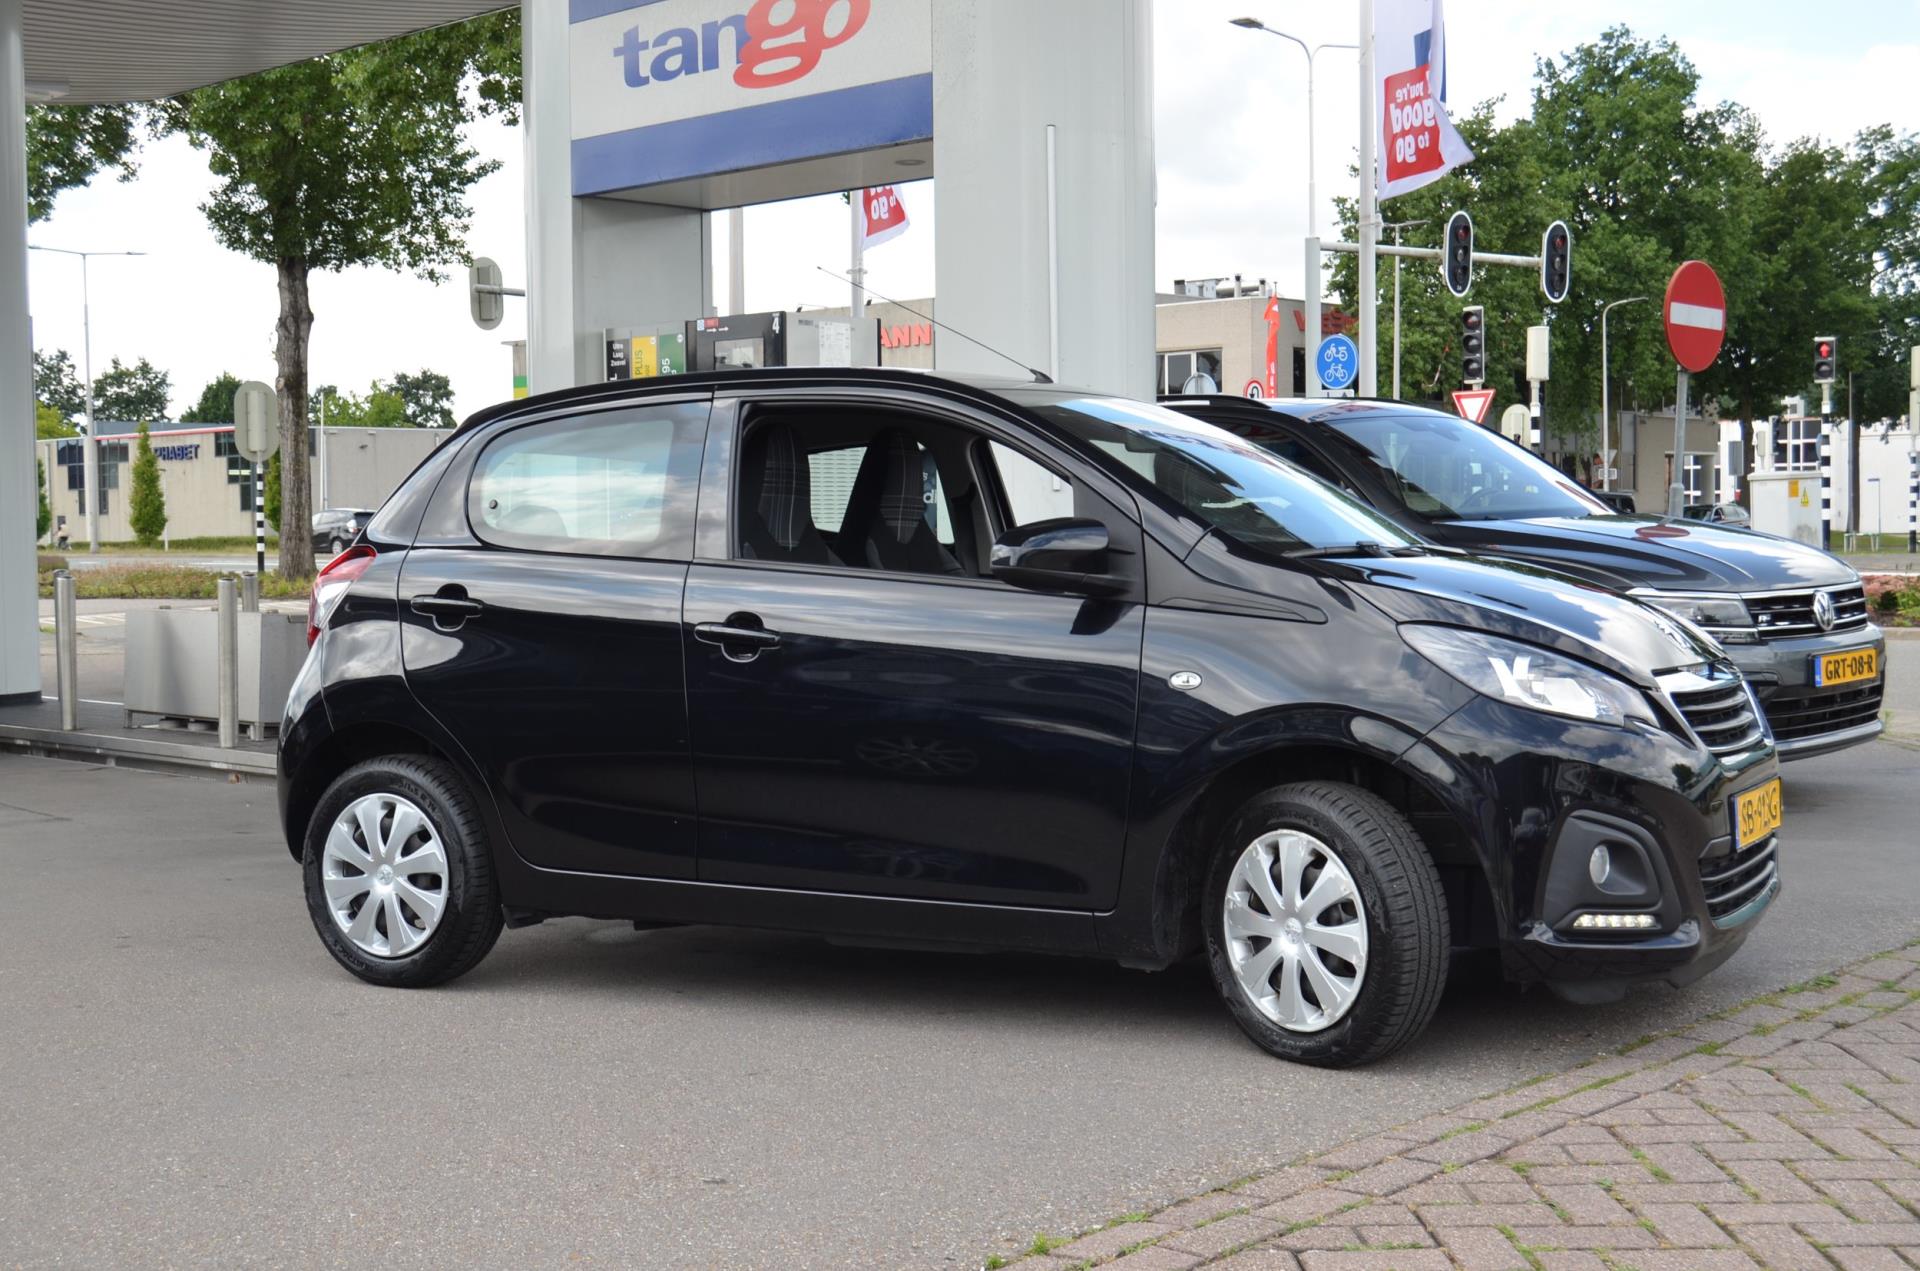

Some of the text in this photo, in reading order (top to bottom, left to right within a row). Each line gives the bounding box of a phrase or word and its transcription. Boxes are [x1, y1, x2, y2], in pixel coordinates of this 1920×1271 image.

[613, 0, 871, 89] tango
[771, 317, 780, 334] 4
[635, 350, 643, 375] PLUS
[1825, 653, 1874, 681] GRT-08-R
